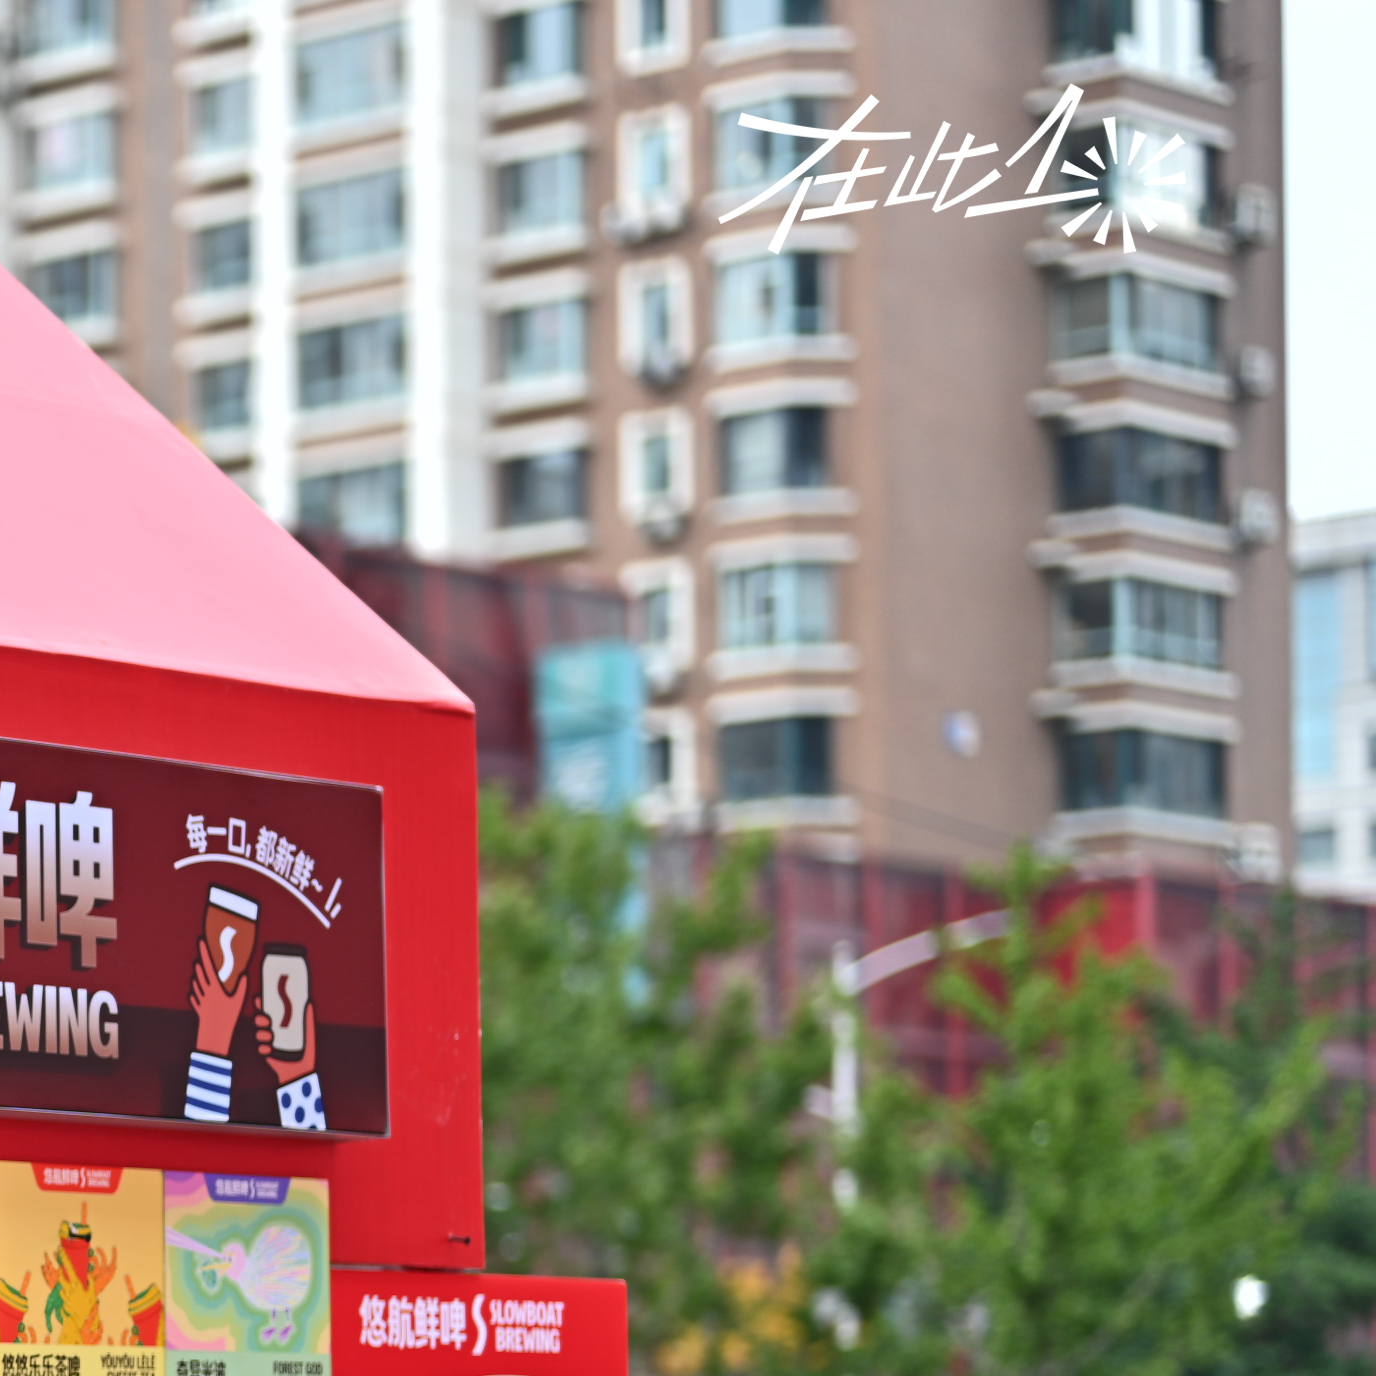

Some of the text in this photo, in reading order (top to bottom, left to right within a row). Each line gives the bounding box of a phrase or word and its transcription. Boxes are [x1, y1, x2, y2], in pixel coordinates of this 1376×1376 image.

[359, 1293, 467, 1354] 悠航鲜啤
[490, 1300, 564, 1329] SLOWBOAT
[495, 1324, 561, 1354] BREWING
